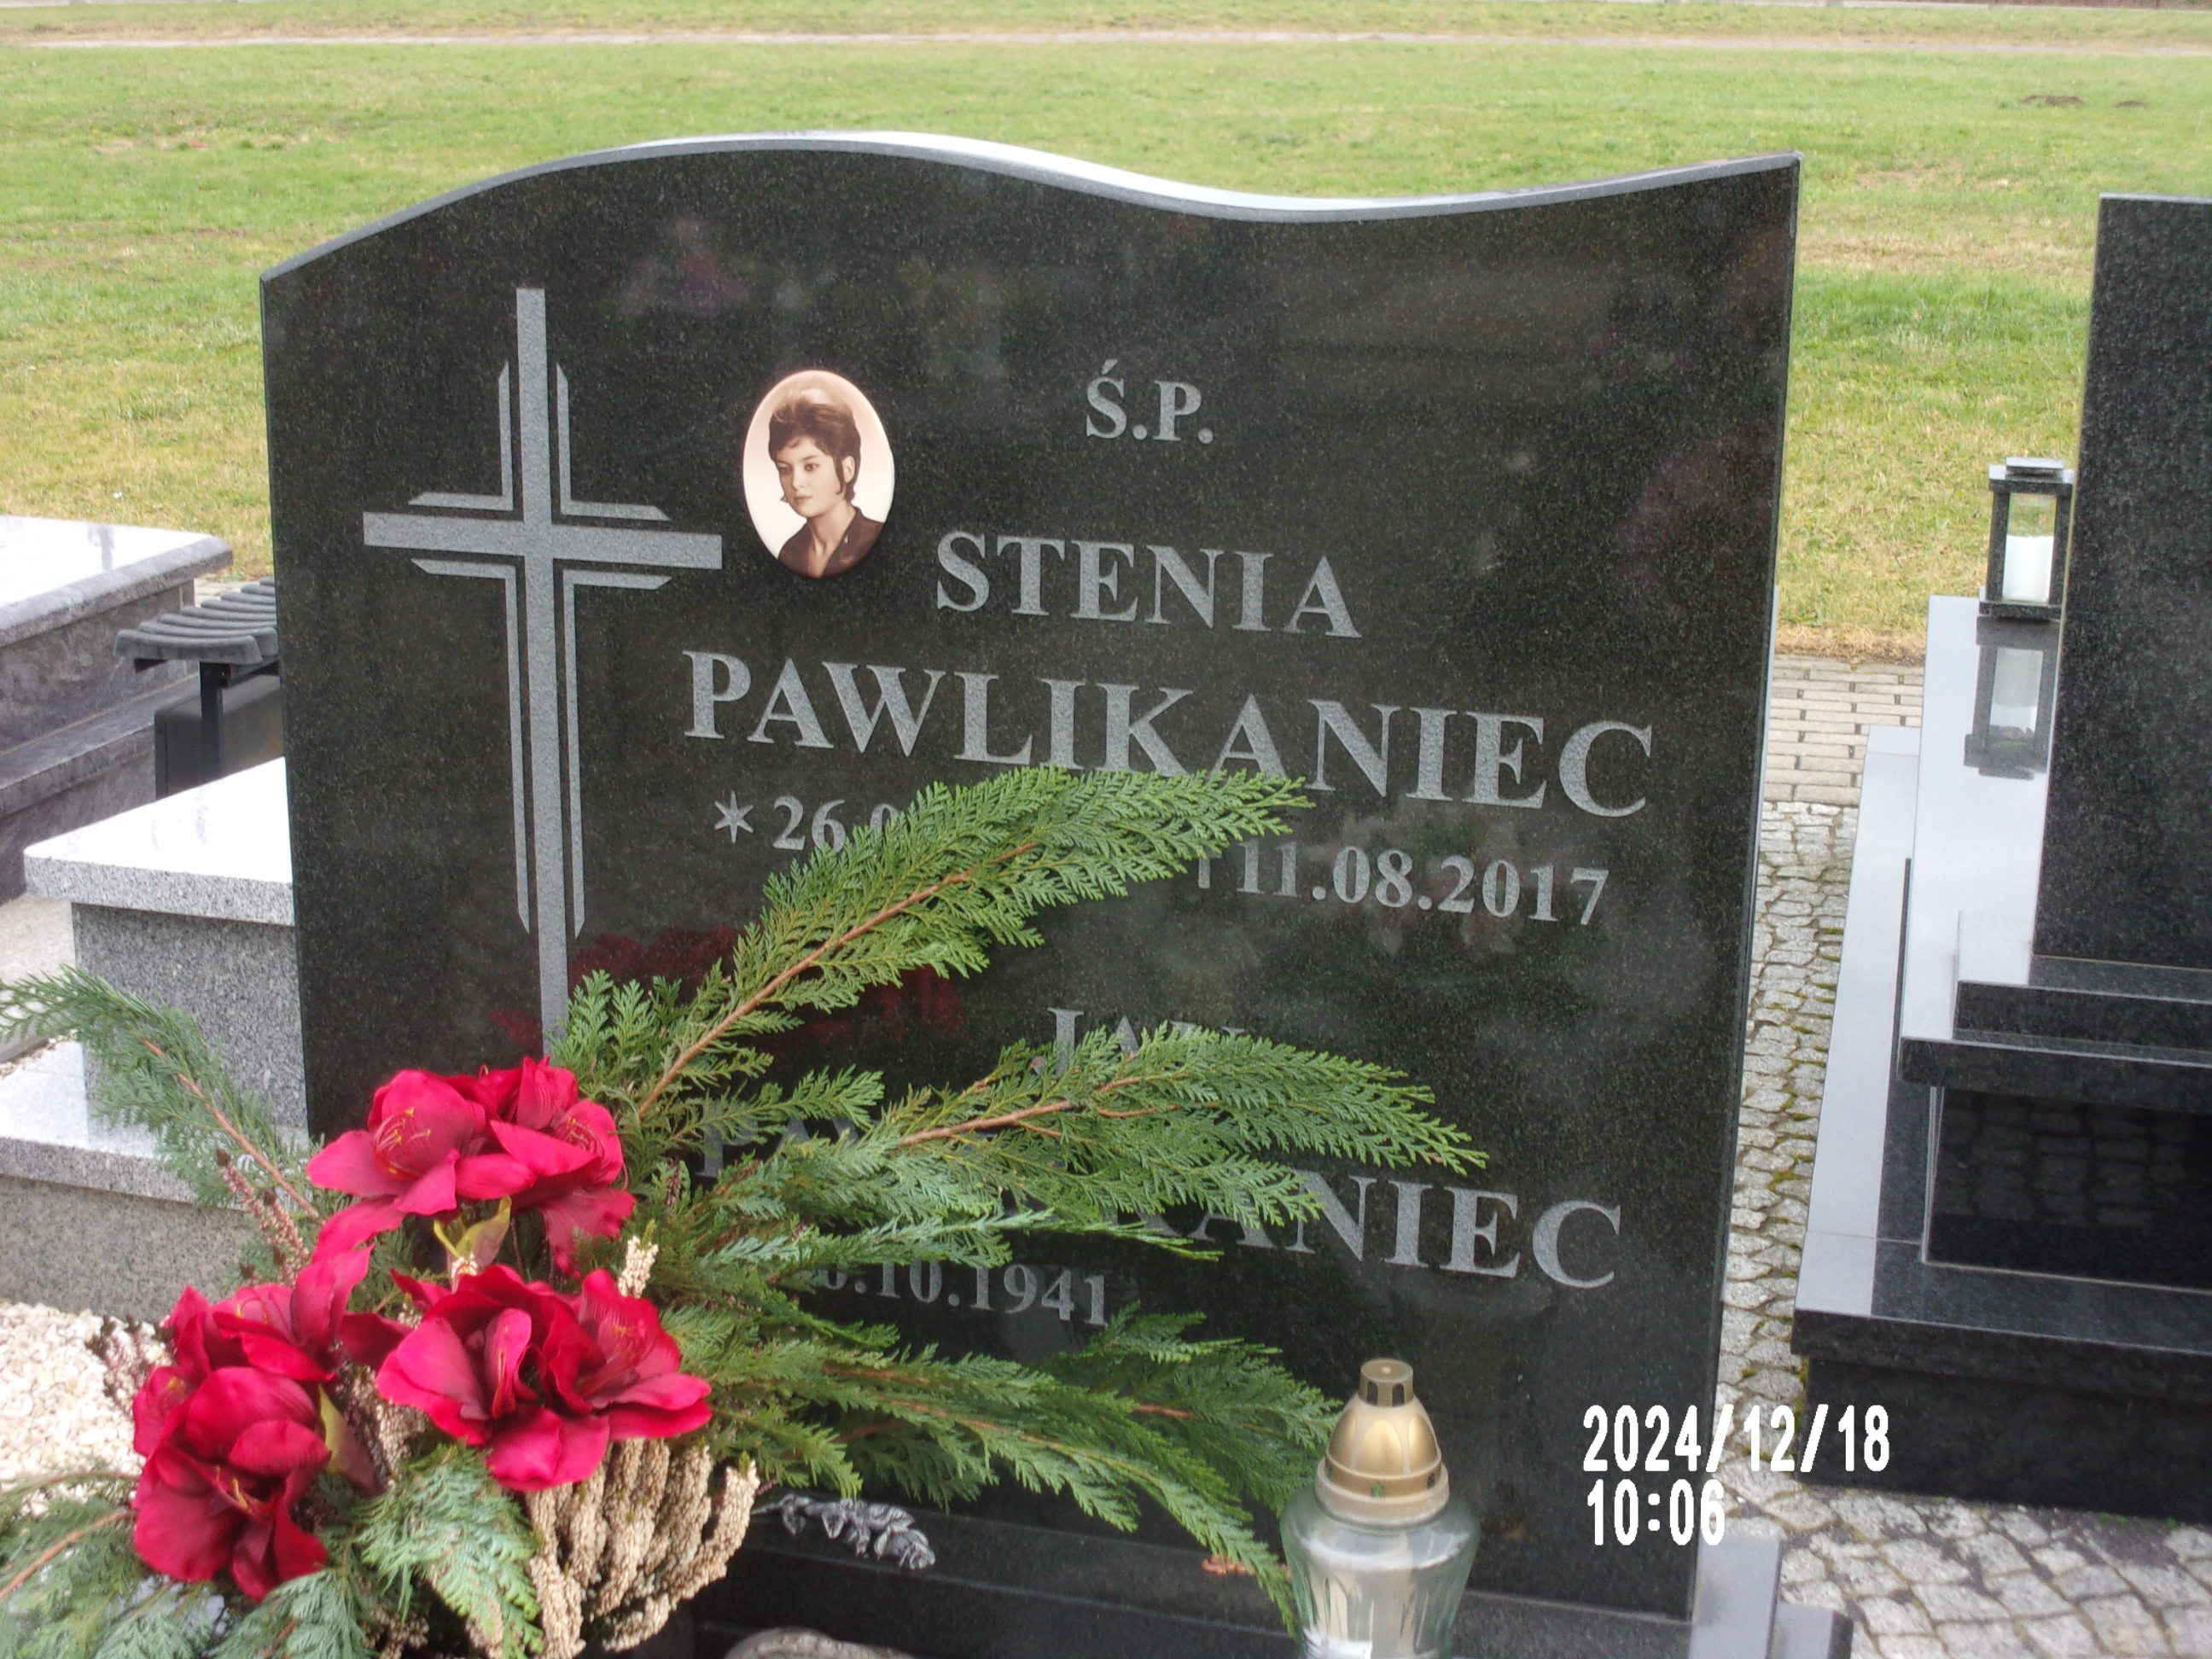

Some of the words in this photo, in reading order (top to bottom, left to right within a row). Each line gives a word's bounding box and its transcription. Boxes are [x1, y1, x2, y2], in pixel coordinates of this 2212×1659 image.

[1086, 358, 1214, 444] Ś.P.
[936, 530, 1363, 639] STENIA
[682, 649, 1653, 818] PAWLIKANIEC
[1237, 839, 1610, 926] 11.08.2017
